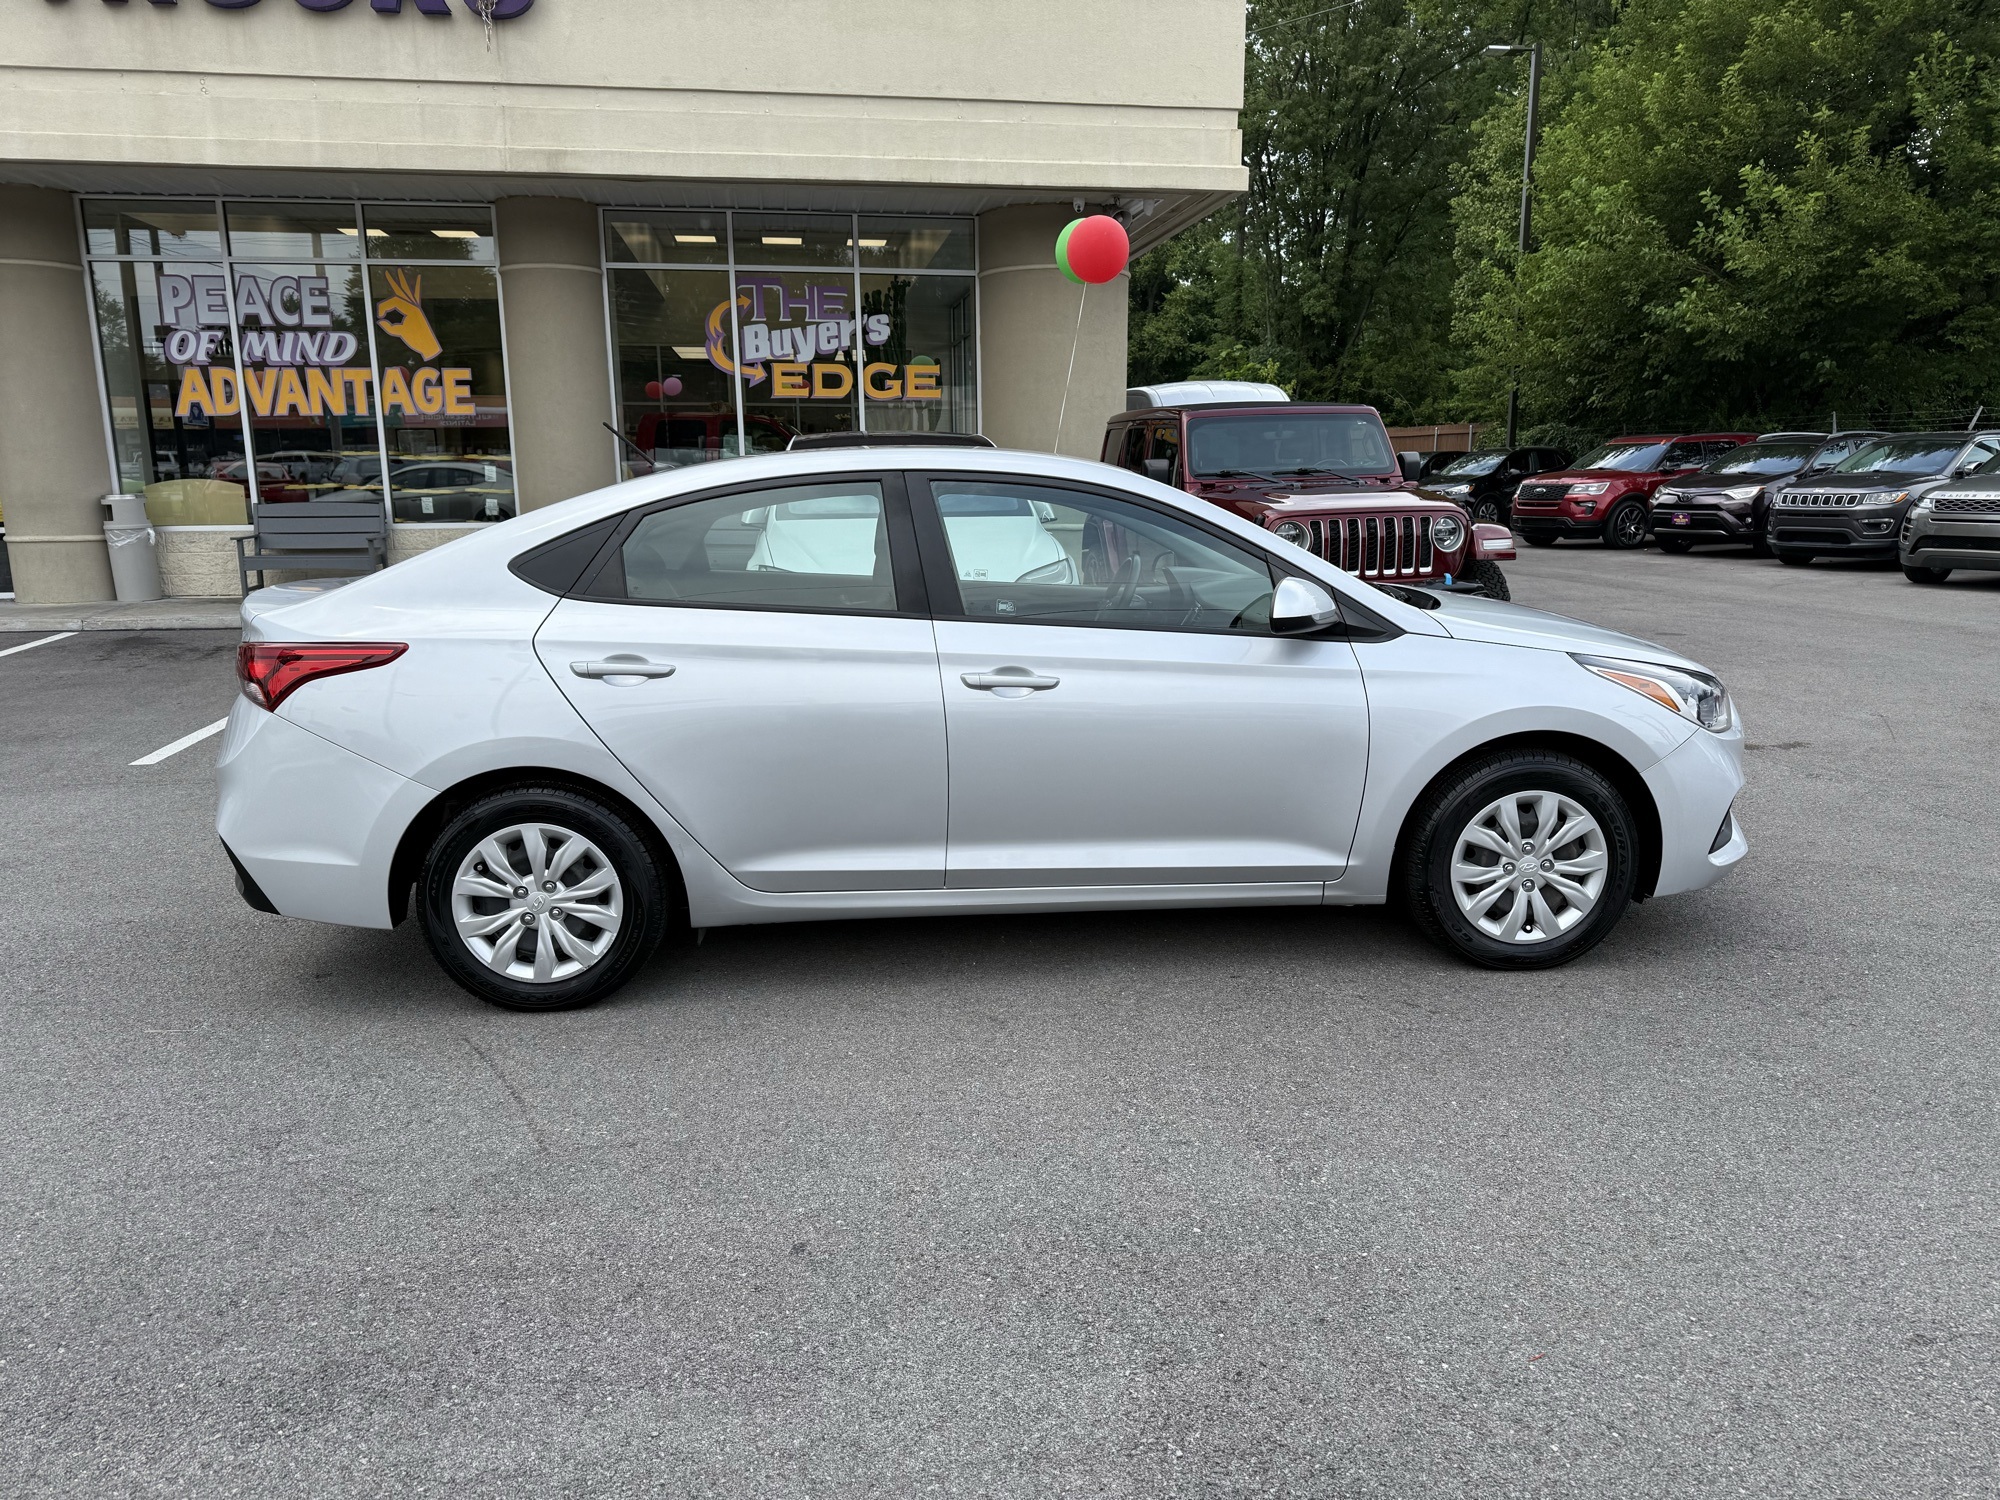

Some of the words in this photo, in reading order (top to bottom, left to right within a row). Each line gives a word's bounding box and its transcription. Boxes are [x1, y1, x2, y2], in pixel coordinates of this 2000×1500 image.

[158, 274, 333, 327] PEACE
[736, 276, 849, 322] THE
[164, 329, 224, 365] OF
[242, 329, 358, 366] MIND
[742, 313, 892, 366] Buyer's
[174, 365, 477, 417] ADVANTAGE
[770, 361, 943, 400] EDGE
